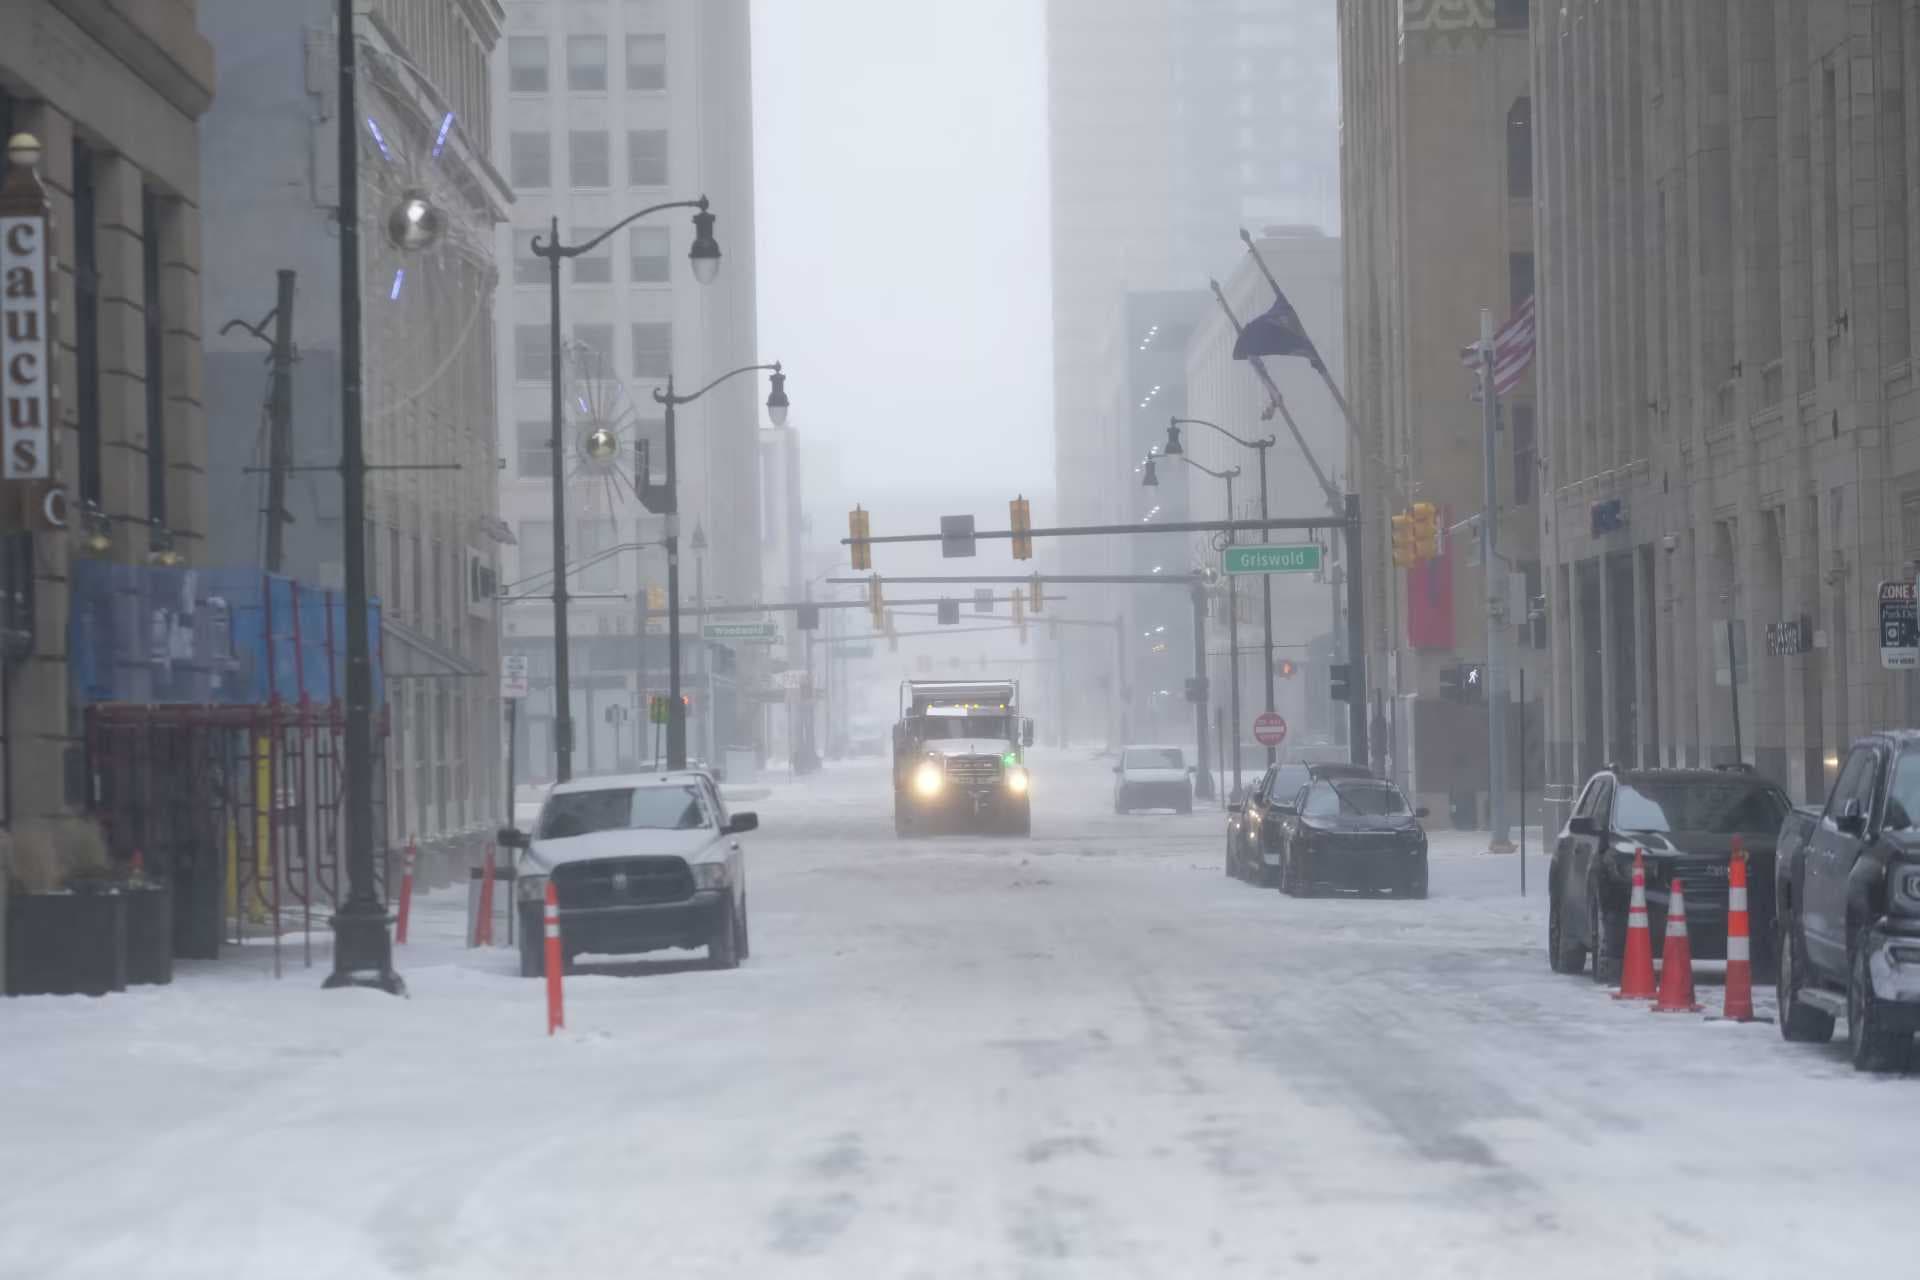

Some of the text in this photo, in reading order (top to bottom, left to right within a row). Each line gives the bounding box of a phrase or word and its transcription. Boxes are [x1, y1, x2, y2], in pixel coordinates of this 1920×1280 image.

[5, 223, 41, 474] caucus
[1240, 551, 1304, 568] Griswold
[1881, 584, 1910, 600] ZONE
